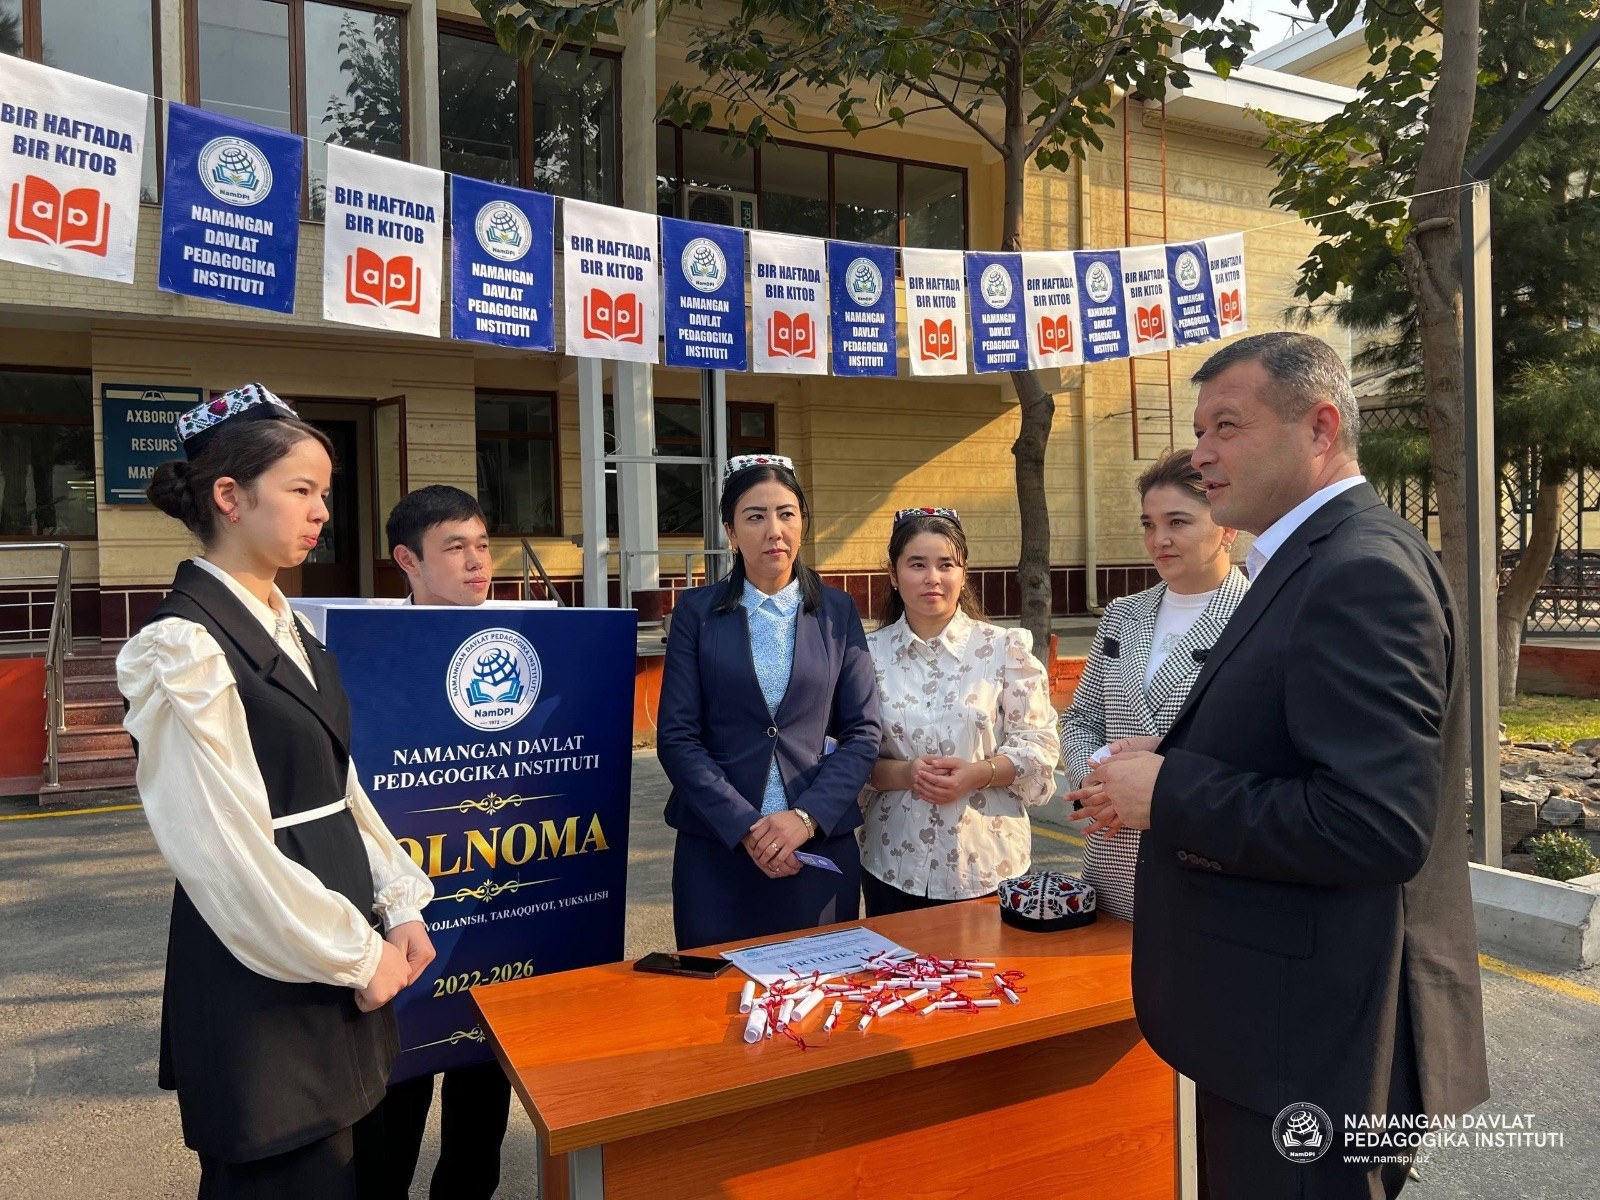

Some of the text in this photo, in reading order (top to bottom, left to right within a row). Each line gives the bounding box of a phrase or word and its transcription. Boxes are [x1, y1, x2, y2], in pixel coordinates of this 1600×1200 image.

[1, 103, 133, 153] BIR HAFTADA
[13, 135, 117, 176] BIR KITOB
[220, 190, 250, 200] NamDPI
[335, 186, 435, 223] BIR HAFTADA
[192, 205, 273, 236] NAMANGAN
[346, 213, 424, 244] BIR KITOB
[205, 229, 259, 253] DAVLAT
[571, 235, 651, 262] BIR HAFTADA
[184, 246, 276, 277] PEDAGOGIKA
[1210, 255, 1241, 271] BIR HAFTADA
[472, 263, 533, 286] NAMANGAN
[581, 259, 644, 281] BIR KITOB
[758, 263, 821, 283] BIR HAFTADA
[1125, 268, 1165, 283] BIR HAFTADA
[1215, 270, 1240, 284] BIR KITOB
[193, 269, 265, 295] INSTITUTI
[909, 277, 960, 291] BIR HAFTADA
[1027, 277, 1074, 291] BIR HAFTADA
[483, 283, 523, 302] DAVLAT
[765, 284, 815, 301] BIR KITOB
[1130, 284, 1163, 298] BIR KITOB
[680, 296, 729, 313] NAMANGAN
[916, 296, 956, 309] BIR KITOB
[1033, 294, 1071, 307] BIR KITOB
[468, 298, 538, 322] PEDAGOGIKA
[845, 311, 885, 324] NAMANGAN
[689, 313, 722, 328] DAVLAT
[982, 313, 1016, 324] NAMANGAN
[476, 317, 530, 338] INSTITUTI
[853, 327, 879, 338] DAVLAT
[989, 327, 1011, 337] DAVLAT
[678, 329, 733, 344] PEDAGOGIKA
[843, 341, 888, 353] PEDAGOGIKA
[982, 339, 1019, 350] PEDAGOGIKA
[685, 345, 728, 360] INSTITUTI
[987, 353, 1016, 364] INSTITUTI
[849, 355, 884, 367] INSTITUTI
[126, 410, 181, 423] AXBOROT
[132, 438, 177, 452] RESURS
[128, 466, 159, 479] MAR
[465, 635, 489, 653] DAVLAT
[491, 633, 530, 655] PEDAGOGIKA
[528, 655, 537, 693] INSTITUTI
[474, 707, 513, 718] NamDPI
[393, 735, 585, 766] NAMANGAN DAVLAT
[372, 754, 600, 791] PEDAGOGIKA INSTITUTI
[490, 901, 556, 921] TARAQQIYOT,
[559, 890, 609, 908] YUKSALISH
[433, 959, 534, 998] 2022-2026
